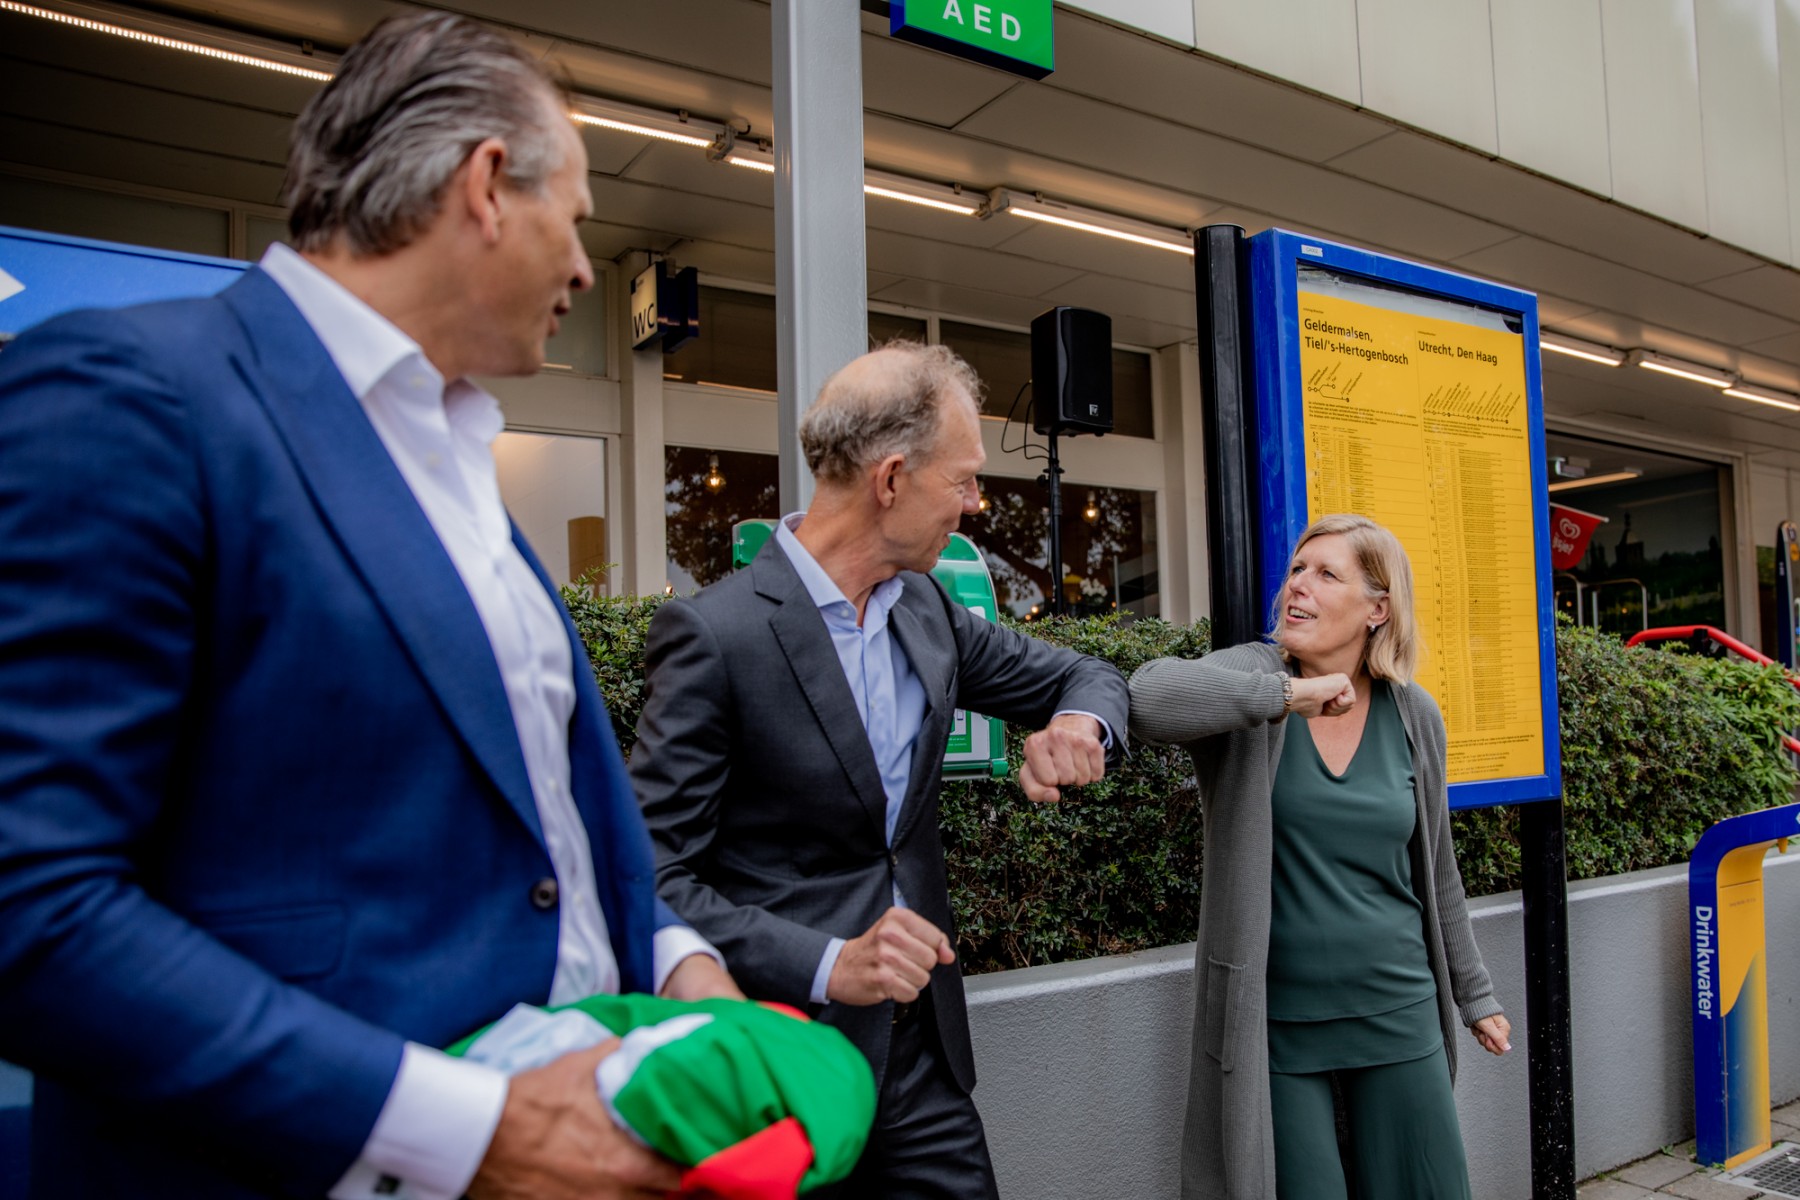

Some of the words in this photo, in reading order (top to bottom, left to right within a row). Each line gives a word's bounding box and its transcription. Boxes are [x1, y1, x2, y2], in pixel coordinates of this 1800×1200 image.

[942, 0, 1021, 42] AED
[634, 303, 655, 339] WC
[1304, 318, 1373, 343] Geldermalsen,
[1305, 336, 1409, 365] Tiel/'s-Hertogenbosch
[1418, 340, 1455, 359] Utrecht,
[1456, 346, 1474, 360] Den
[1476, 348, 1498, 366] Haag
[1695, 905, 1715, 1020] Drinkwater
